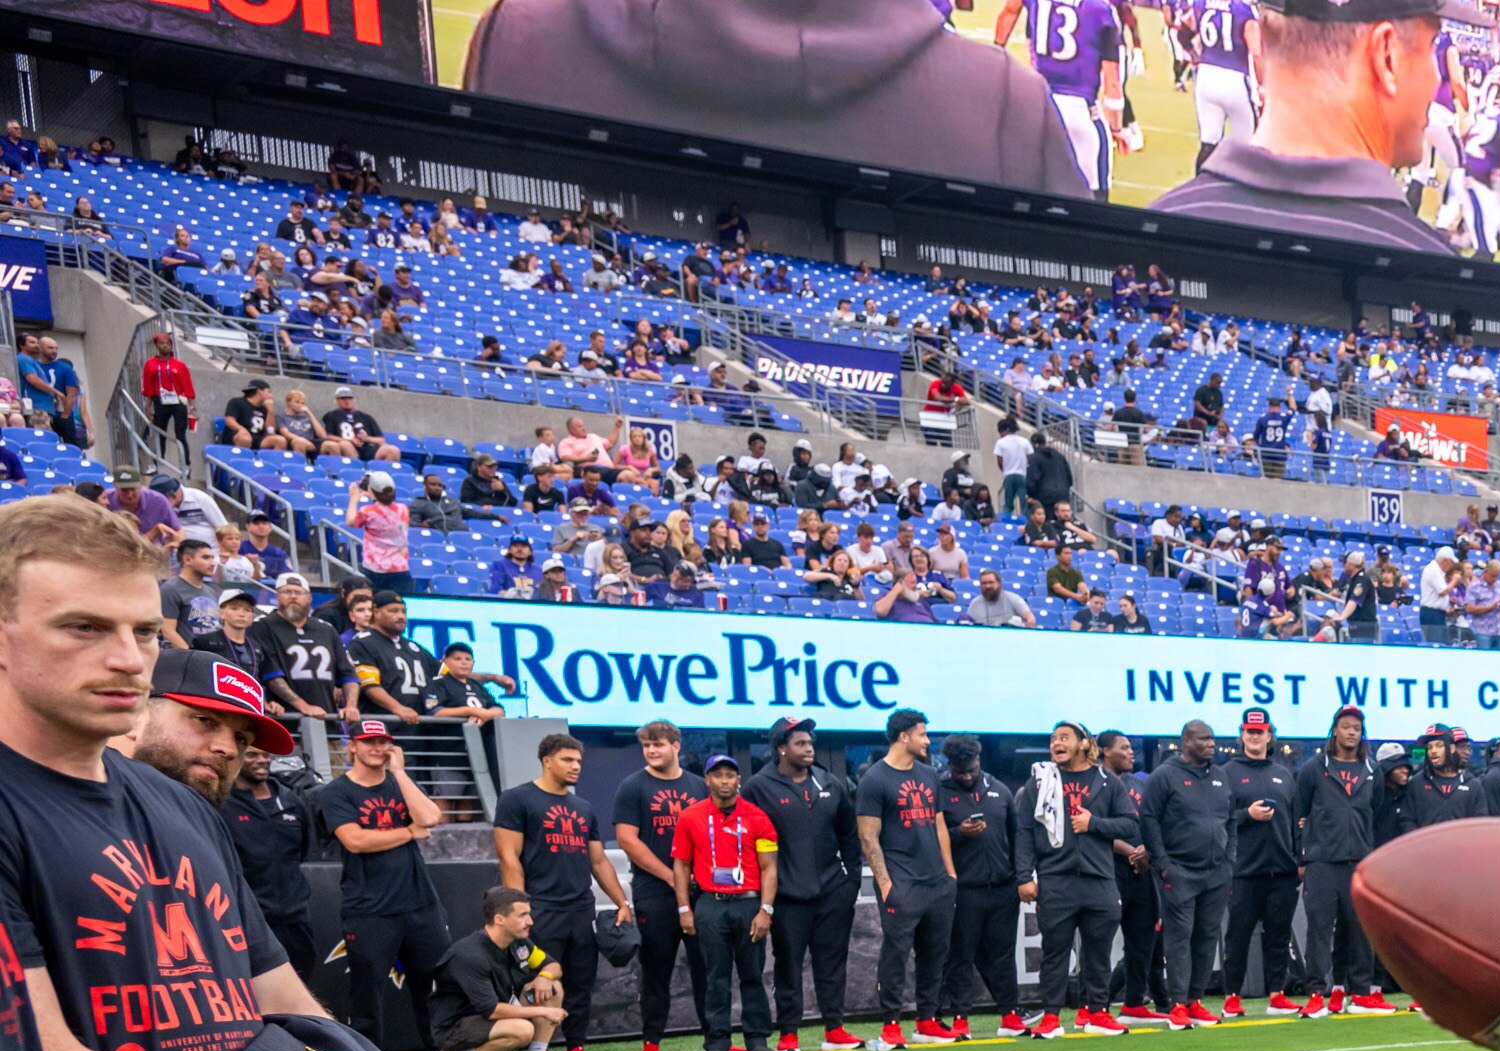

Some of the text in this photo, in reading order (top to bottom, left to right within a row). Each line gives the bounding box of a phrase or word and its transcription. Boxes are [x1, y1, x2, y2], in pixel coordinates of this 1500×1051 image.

[1035, 0, 1078, 61] 13
[1200, 9, 1233, 51] 61
[1370, 495, 1400, 523] 139
[286, 645, 333, 680] 22
[722, 630, 900, 710] Price
[1126, 668, 1306, 705] INVEST
[1336, 676, 1449, 709] WITH
[545, 833, 587, 848] FOOTBAL
[75, 838, 249, 957] MARYLAND
[147, 900, 213, 968] M
[89, 978, 263, 1035] FOOTBAL
[160, 1034, 211, 1049] UNIVERSITY
